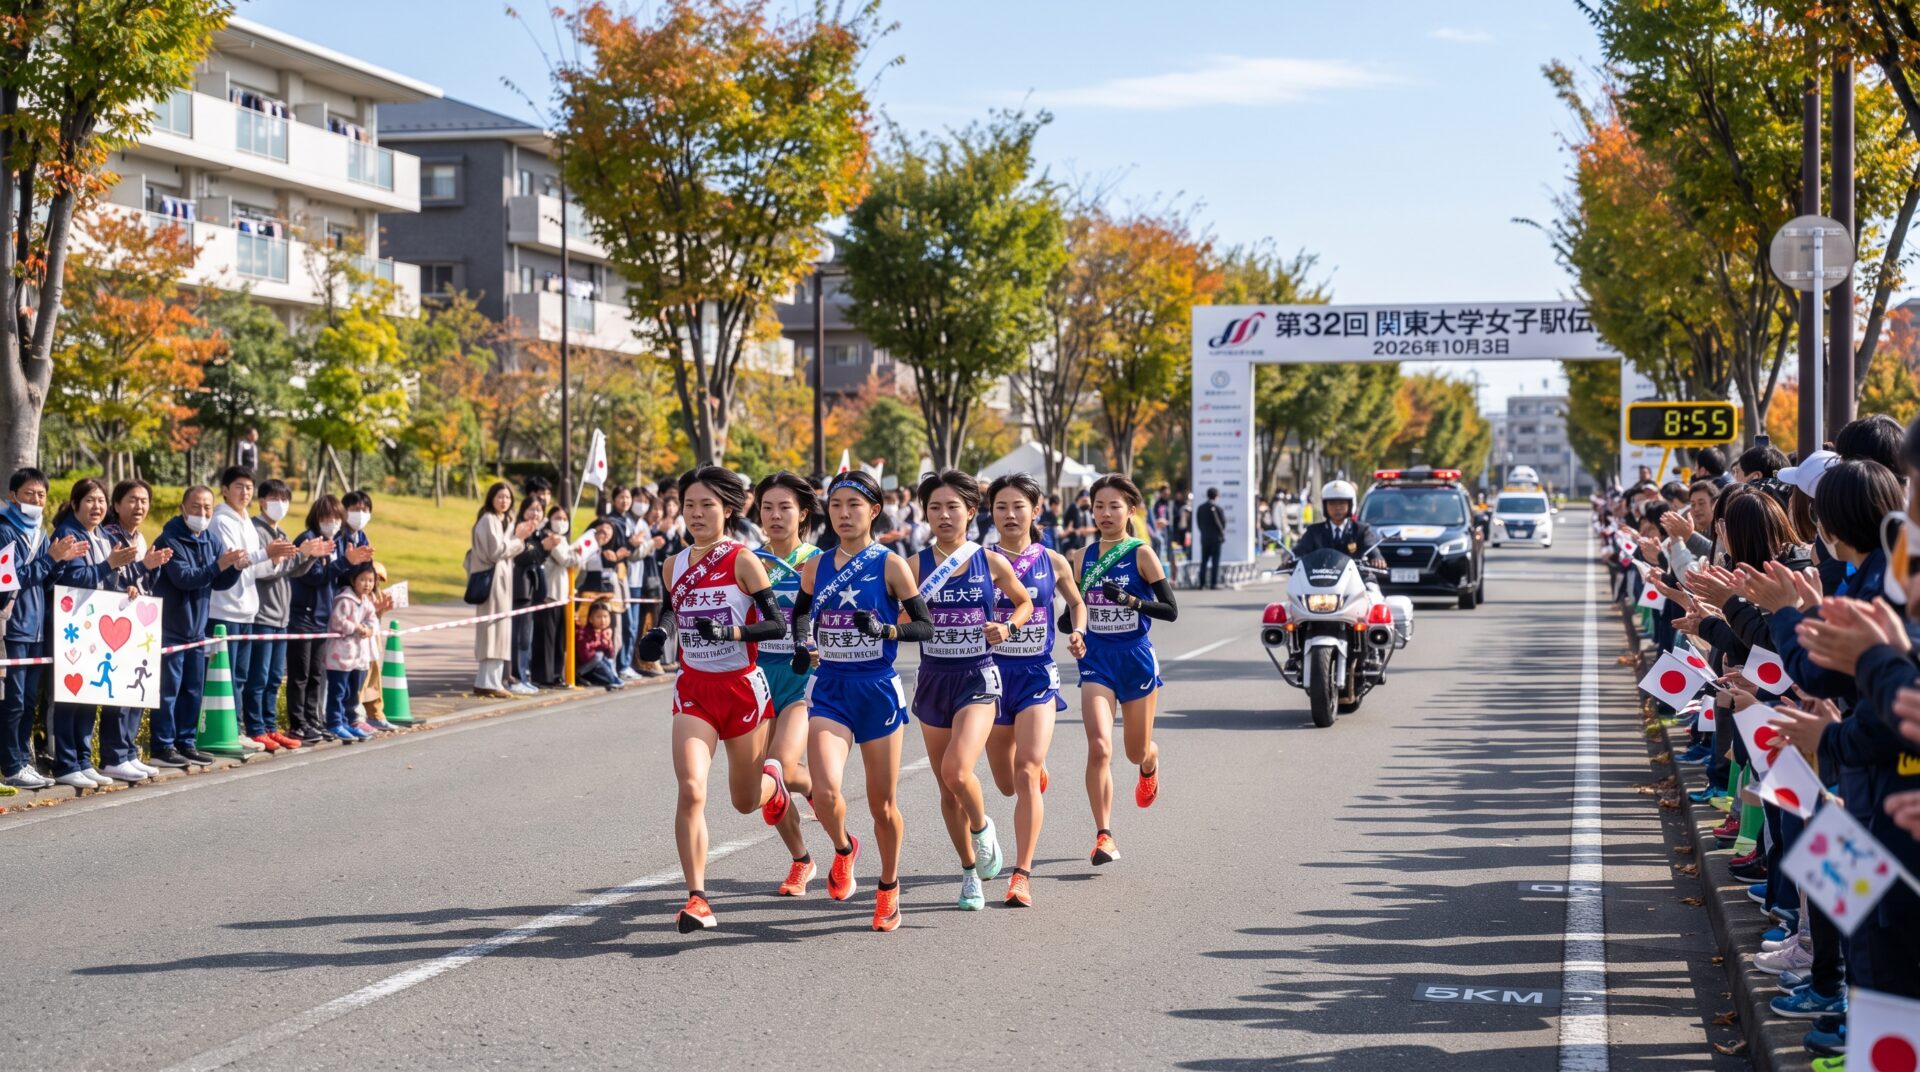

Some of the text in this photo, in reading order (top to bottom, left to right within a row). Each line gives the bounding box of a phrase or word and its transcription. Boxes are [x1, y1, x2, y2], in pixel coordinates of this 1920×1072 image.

[1275, 307, 1593, 338] 第32回 関東大学女子駅伝
[1373, 338, 1510, 356] 2026年10月3日
[1664, 409, 1728, 436] 8:55
[1424, 986, 1544, 1004] 5KM
